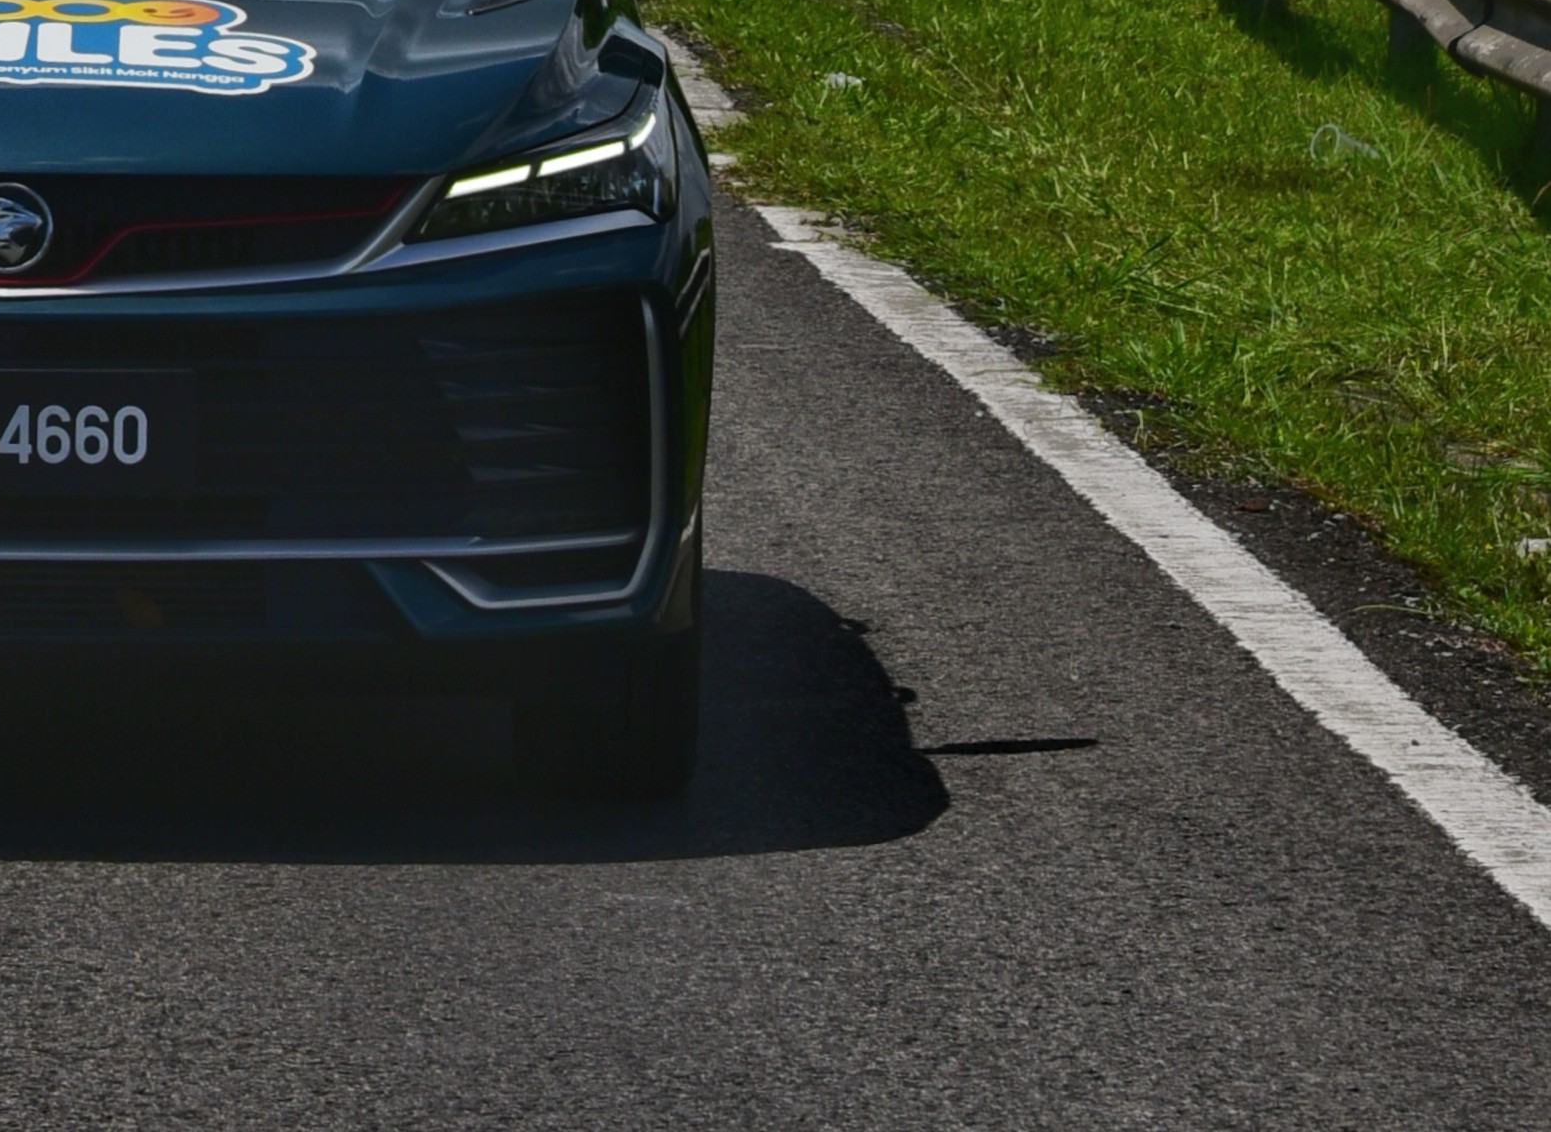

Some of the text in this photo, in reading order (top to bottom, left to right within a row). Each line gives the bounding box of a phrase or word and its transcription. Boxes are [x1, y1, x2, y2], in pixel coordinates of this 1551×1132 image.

[70, 66, 113, 76] Sikit
[115, 68, 159, 78] Mok
[162, 71, 245, 84] Nangga
